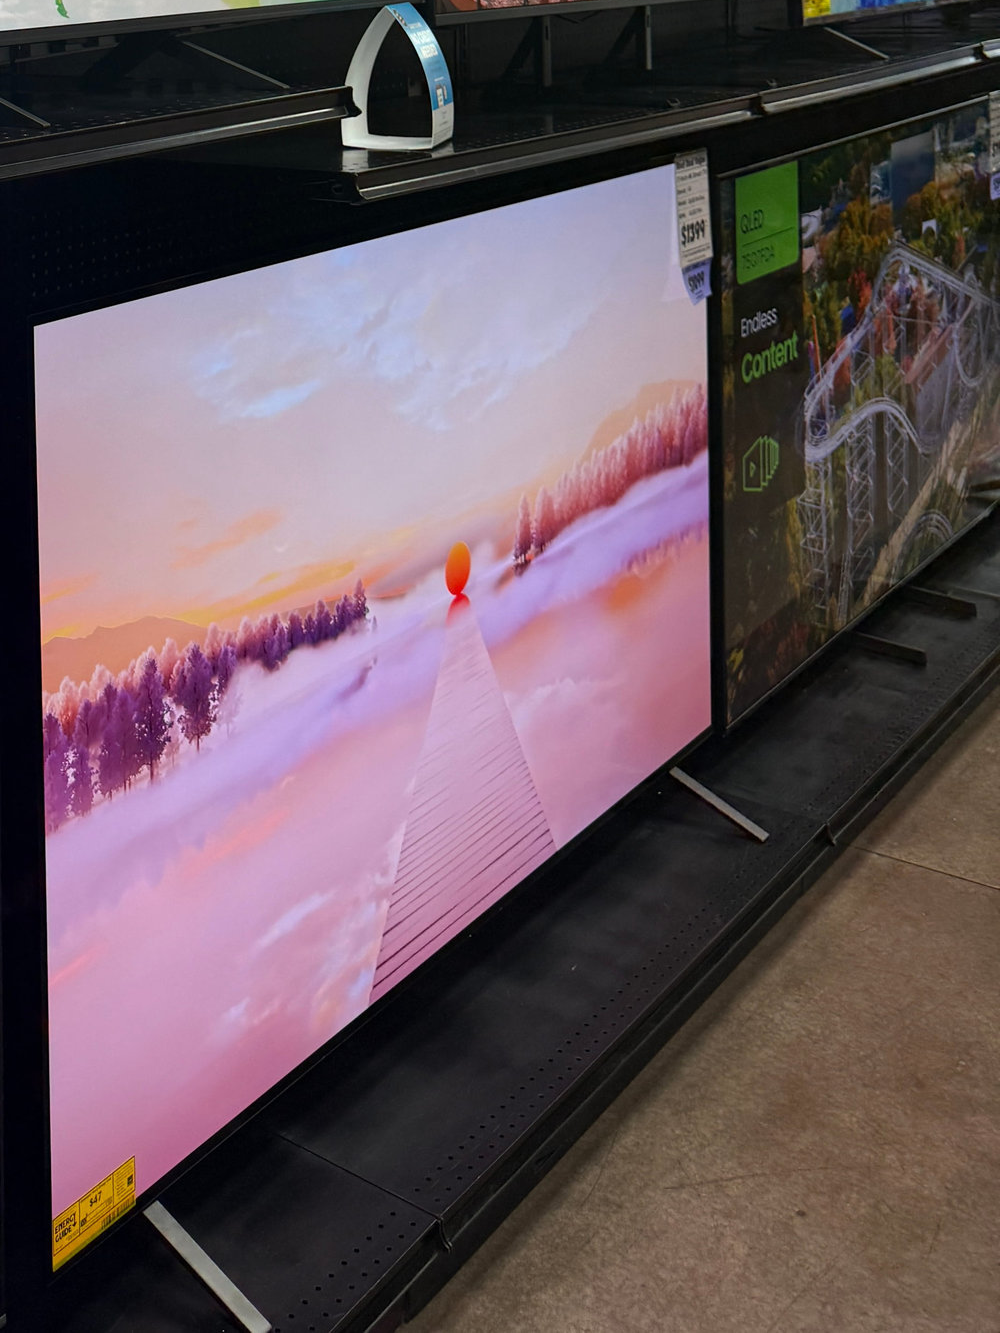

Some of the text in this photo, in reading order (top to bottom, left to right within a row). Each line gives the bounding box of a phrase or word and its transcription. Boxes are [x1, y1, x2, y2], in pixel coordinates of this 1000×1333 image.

[681, 218, 705, 247] $1399
[741, 209, 764, 234] QLED
[740, 307, 778, 338] Endless
[741, 330, 799, 384] Content
